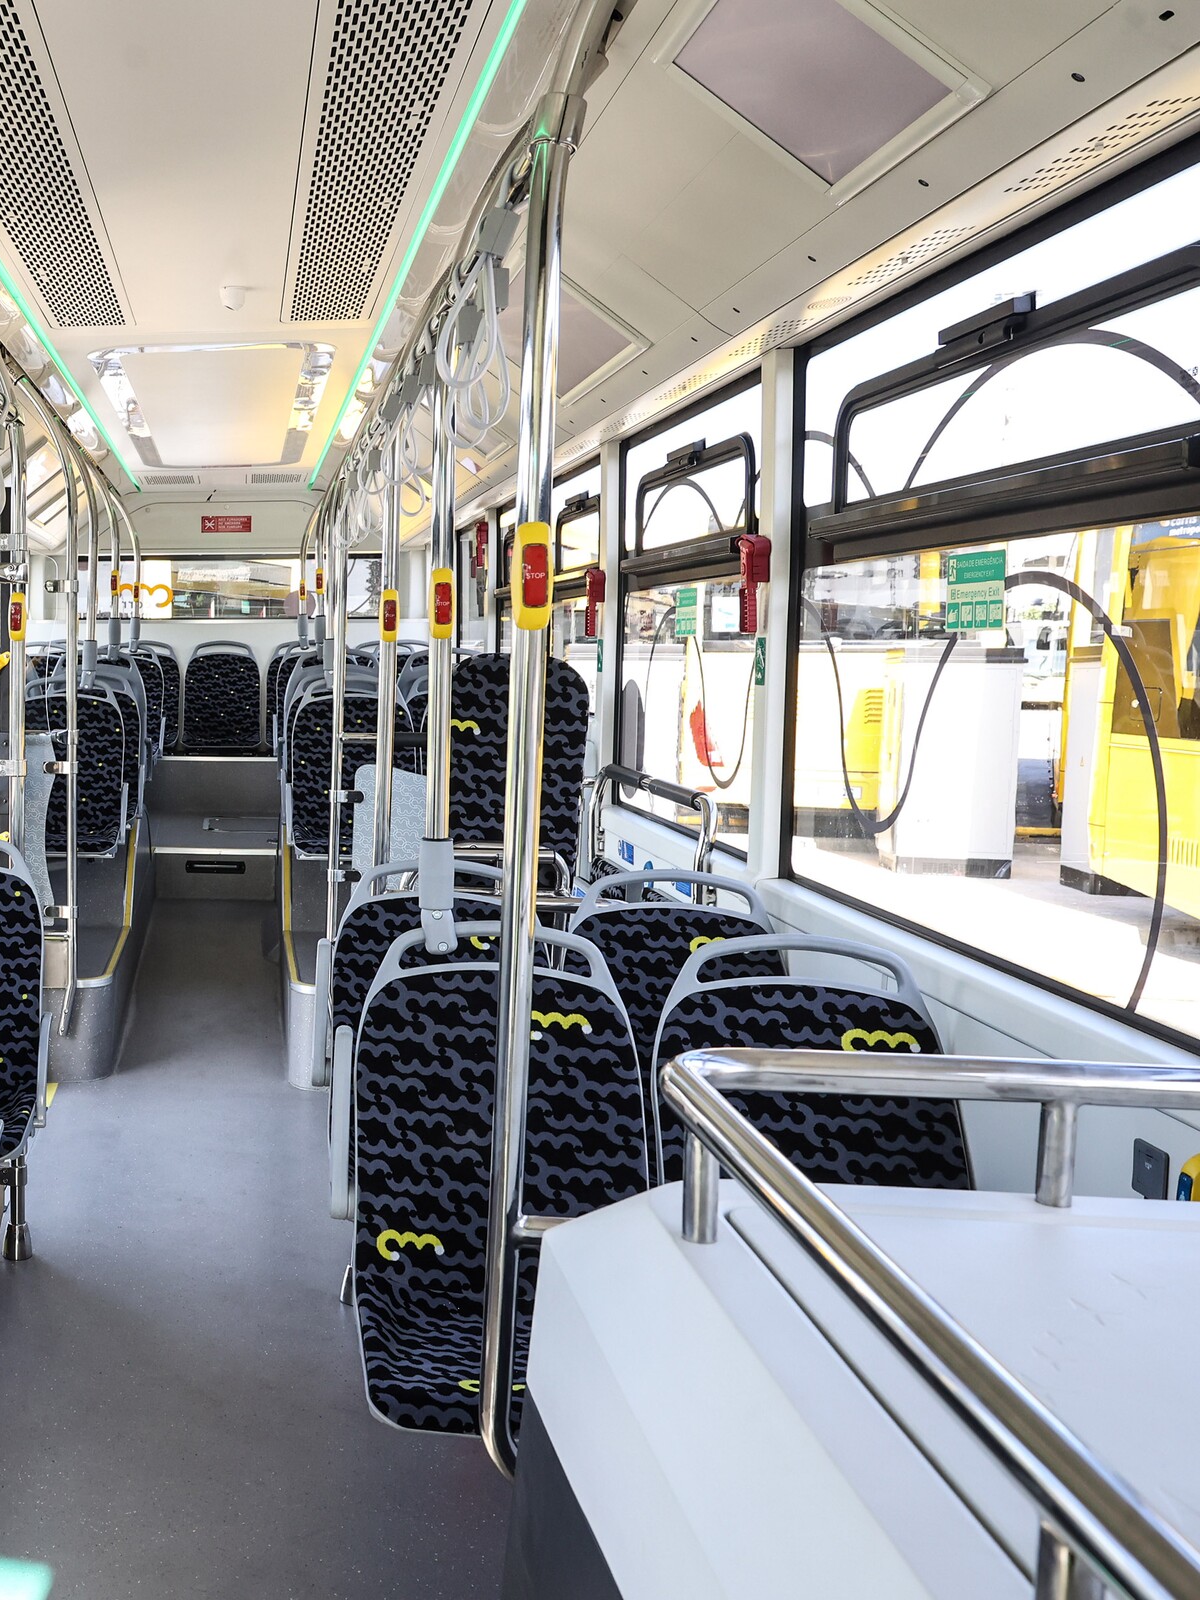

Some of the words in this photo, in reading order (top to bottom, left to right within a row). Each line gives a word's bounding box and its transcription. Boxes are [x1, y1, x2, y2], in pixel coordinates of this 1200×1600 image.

[525, 572, 546, 580] STOP
[957, 588, 987, 600] Emergency
[988, 586, 1000, 597] Exit
